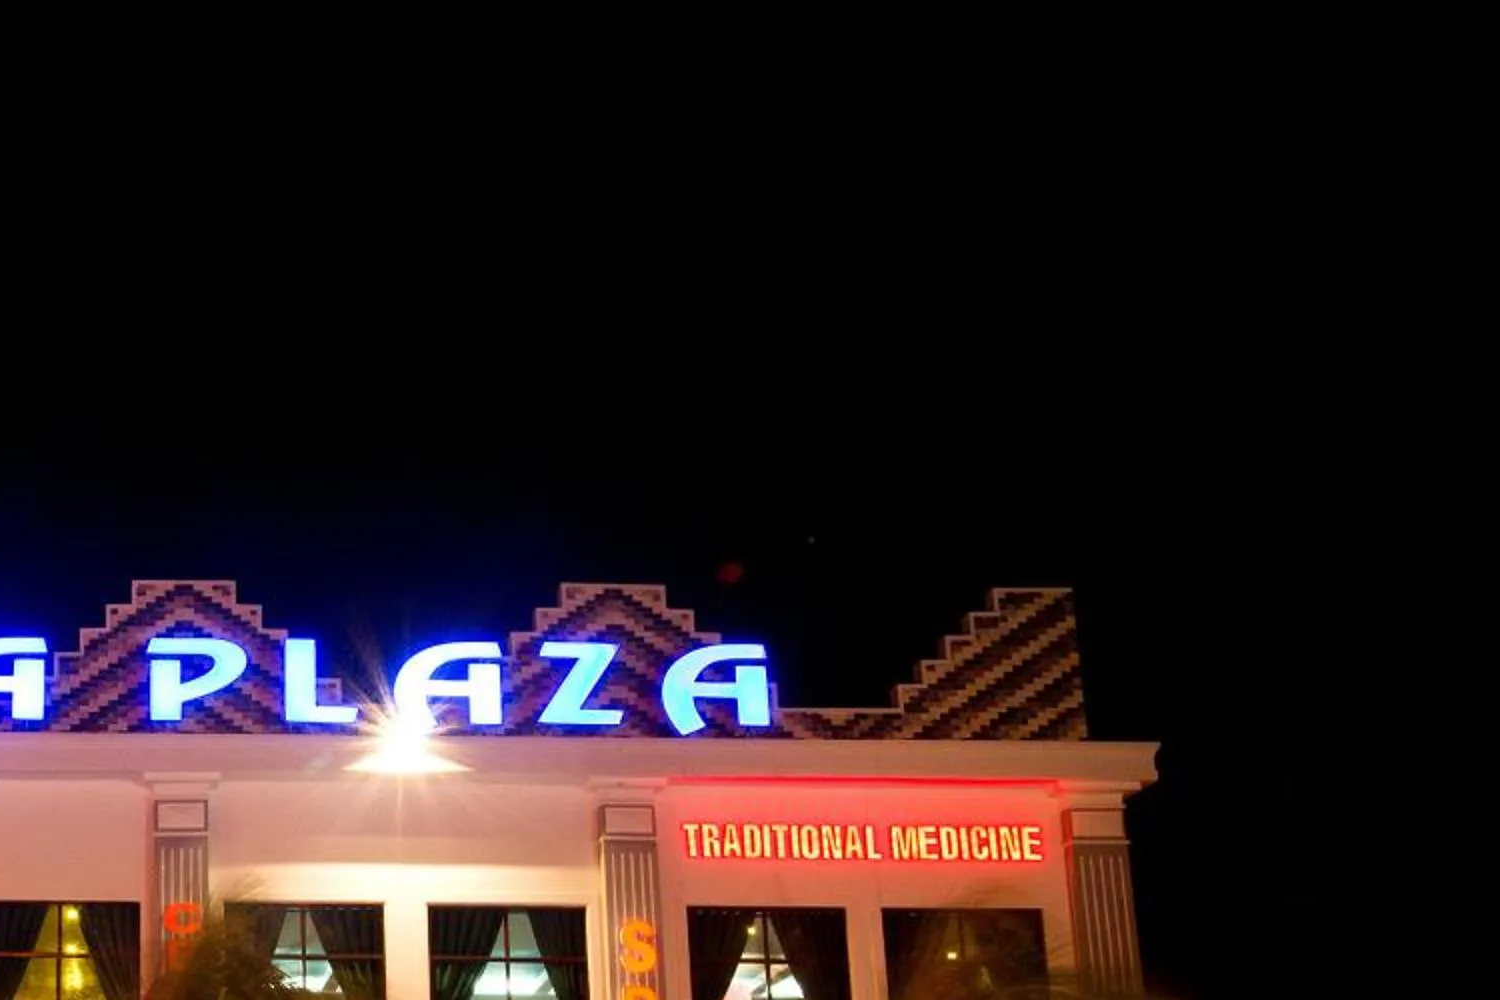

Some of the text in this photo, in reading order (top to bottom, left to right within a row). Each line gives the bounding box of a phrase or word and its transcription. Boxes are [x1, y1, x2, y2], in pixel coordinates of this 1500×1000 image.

[145, 637, 772, 736] PLAZA
[682, 823, 1043, 862] TRADITIONAL MEDICINE
